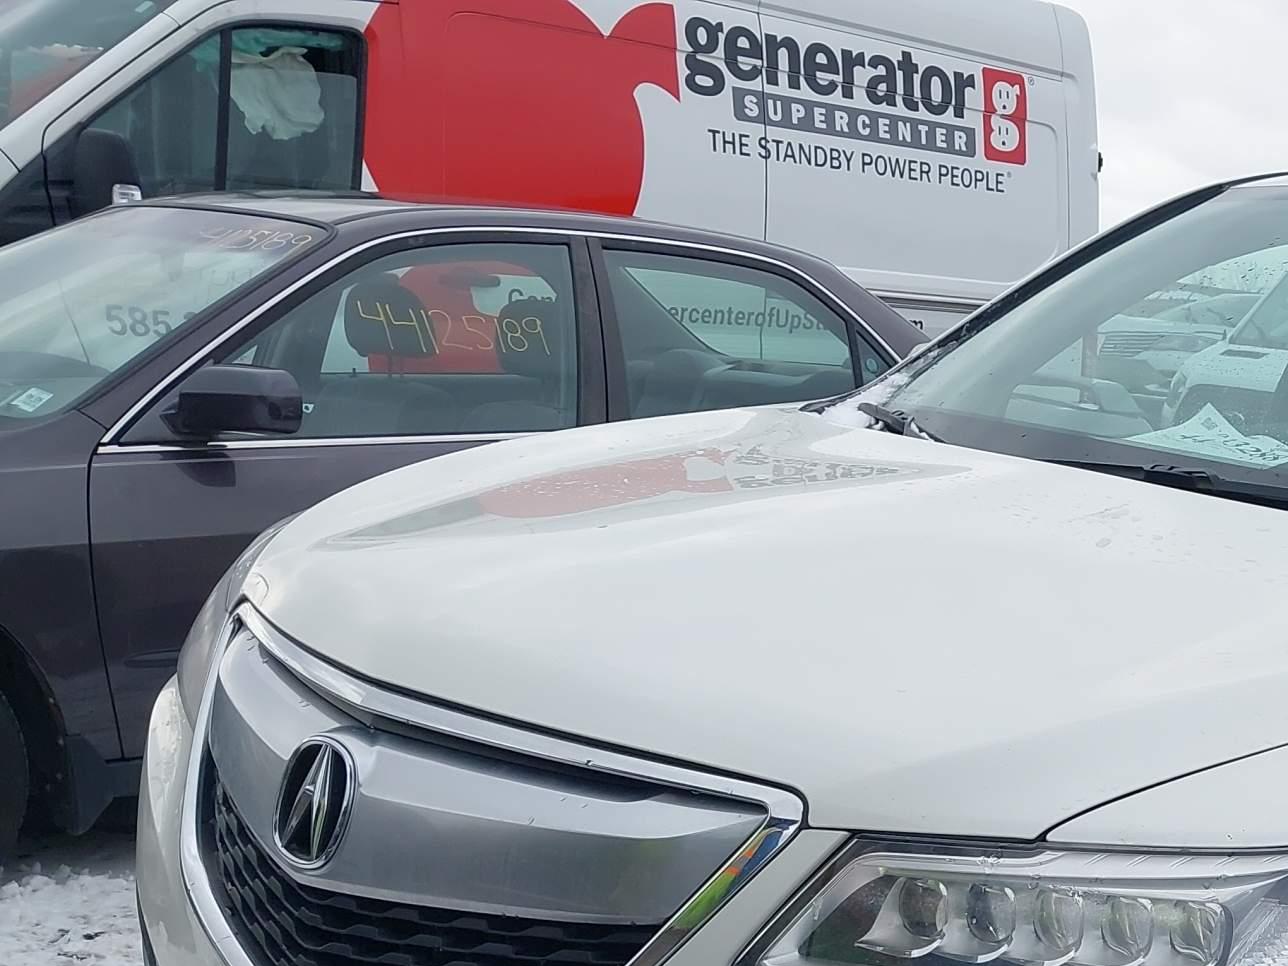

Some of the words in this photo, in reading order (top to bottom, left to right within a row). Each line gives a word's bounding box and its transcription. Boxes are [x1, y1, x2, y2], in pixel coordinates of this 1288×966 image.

[684, 16, 976, 119] generator
[743, 94, 968, 151] SUPERCENTER
[707, 129, 750, 158] THE
[758, 137, 855, 173] STANDBY
[861, 153, 931, 184] POWER
[938, 167, 1005, 194] PEOPLE
[356, 300, 551, 356] 44125189
